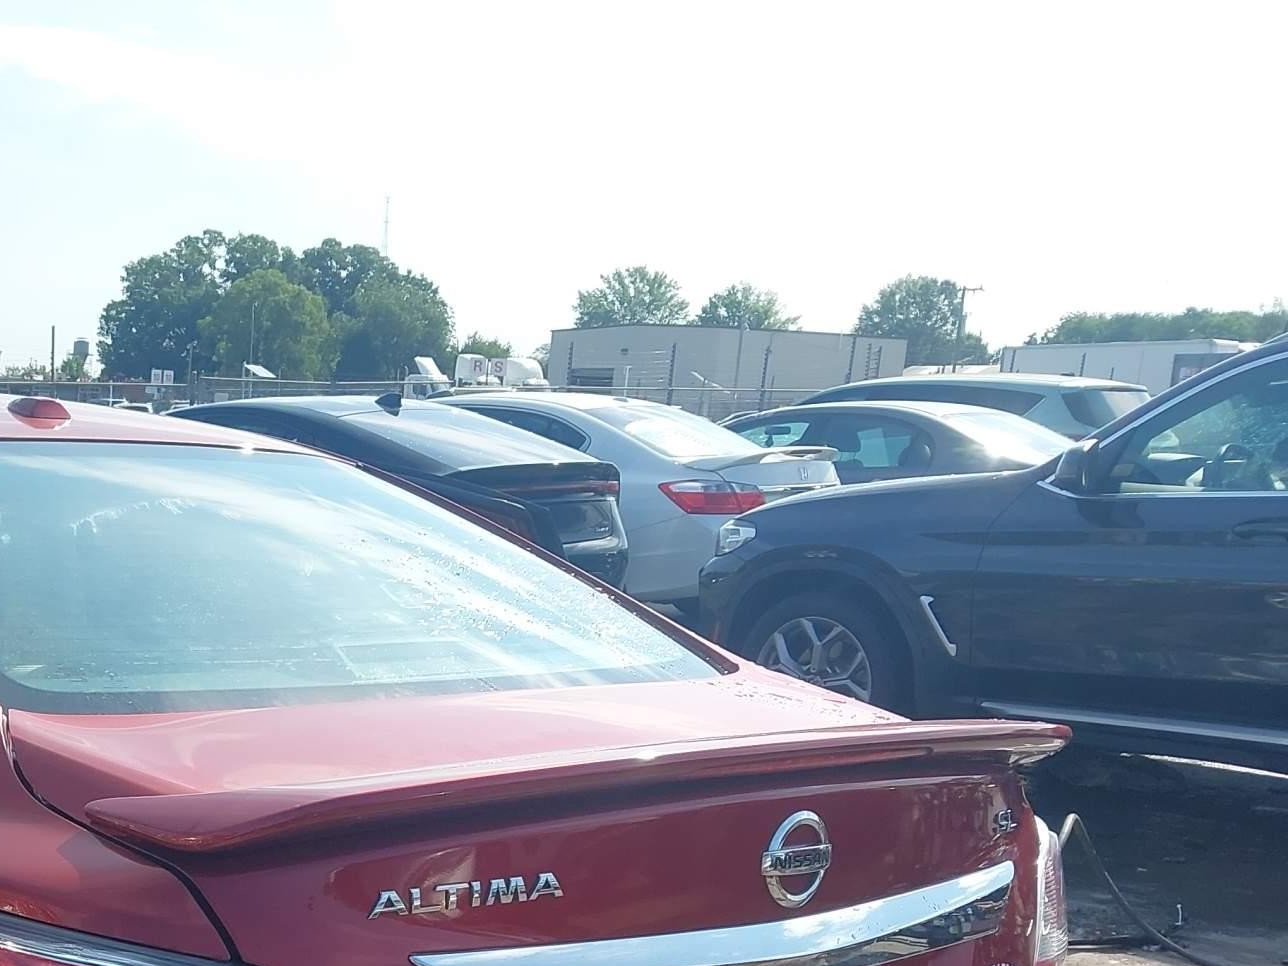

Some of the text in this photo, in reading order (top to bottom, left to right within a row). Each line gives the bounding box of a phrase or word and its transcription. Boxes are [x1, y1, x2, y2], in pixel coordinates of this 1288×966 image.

[473, 360, 482, 372] R
[494, 361, 504, 373] S
[771, 848, 829, 870] NISSAN
[368, 872, 564, 920] ALTIMA
